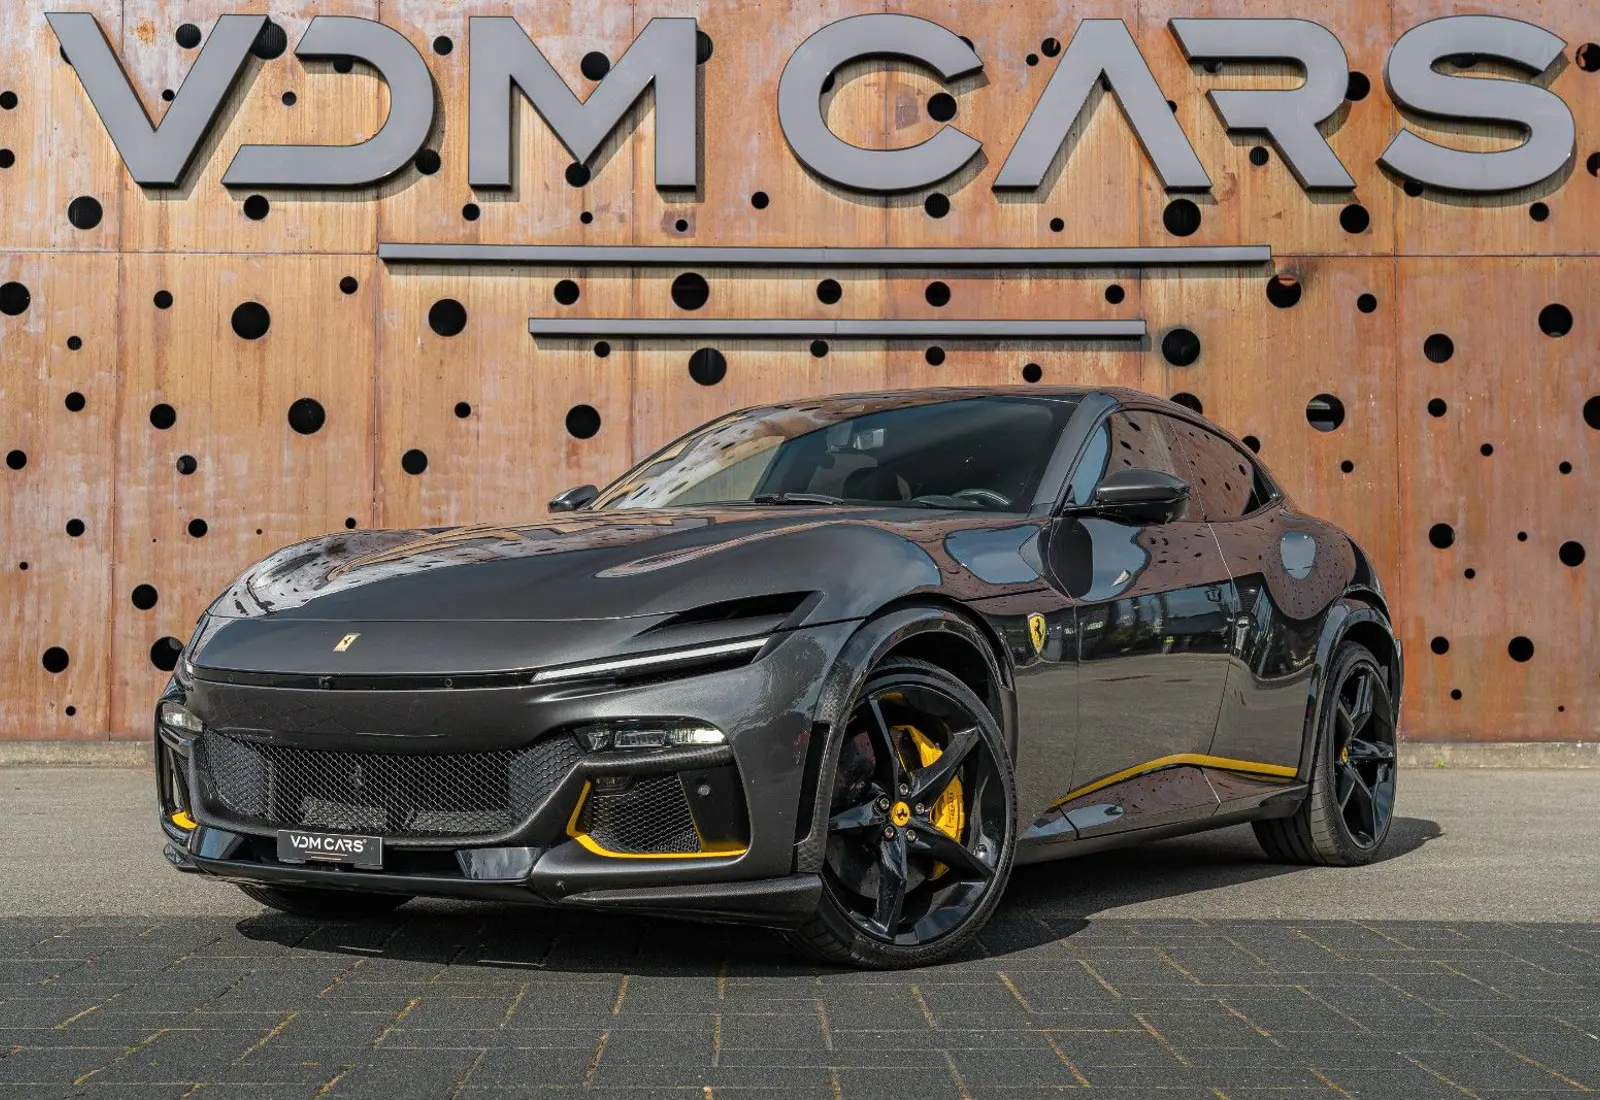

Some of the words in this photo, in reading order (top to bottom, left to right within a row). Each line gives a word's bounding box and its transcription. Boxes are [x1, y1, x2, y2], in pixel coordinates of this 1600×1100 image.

[44, 12, 698, 189] VDM
[777, 12, 1576, 193] CARS
[290, 834, 321, 849] VDM
